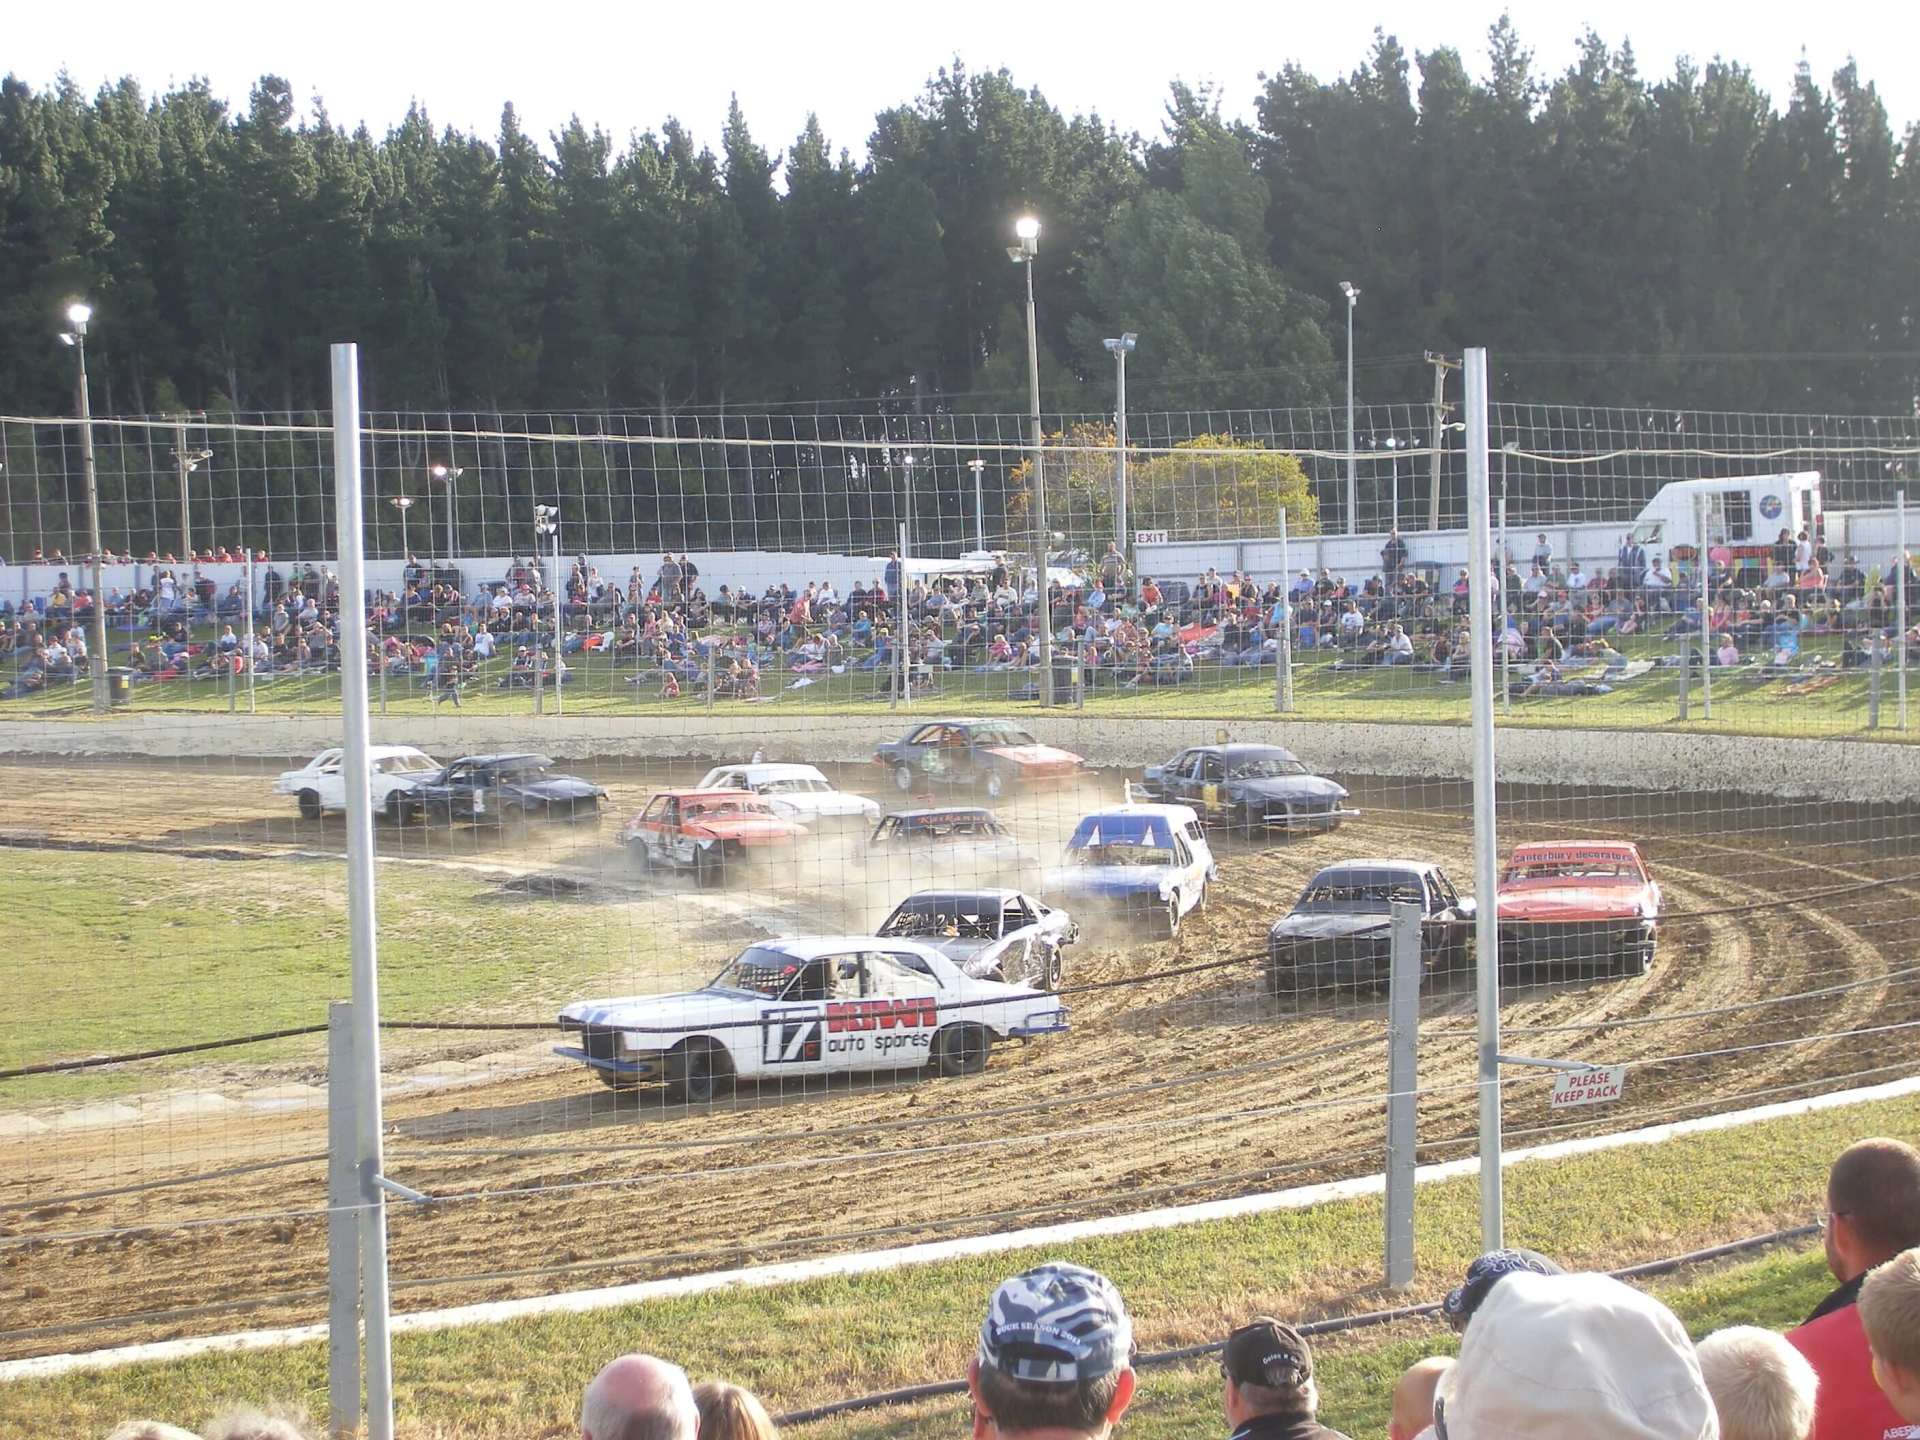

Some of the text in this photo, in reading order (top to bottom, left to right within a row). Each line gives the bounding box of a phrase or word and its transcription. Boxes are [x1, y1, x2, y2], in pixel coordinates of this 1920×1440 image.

[1137, 533, 1166, 543] EXIT
[828, 1032, 930, 1056] auto spares
[1569, 1072, 1611, 1088] PLEASE
[1554, 1084, 1618, 1104] KEEP BACK
[1021, 1321, 1060, 1335] SEASON
